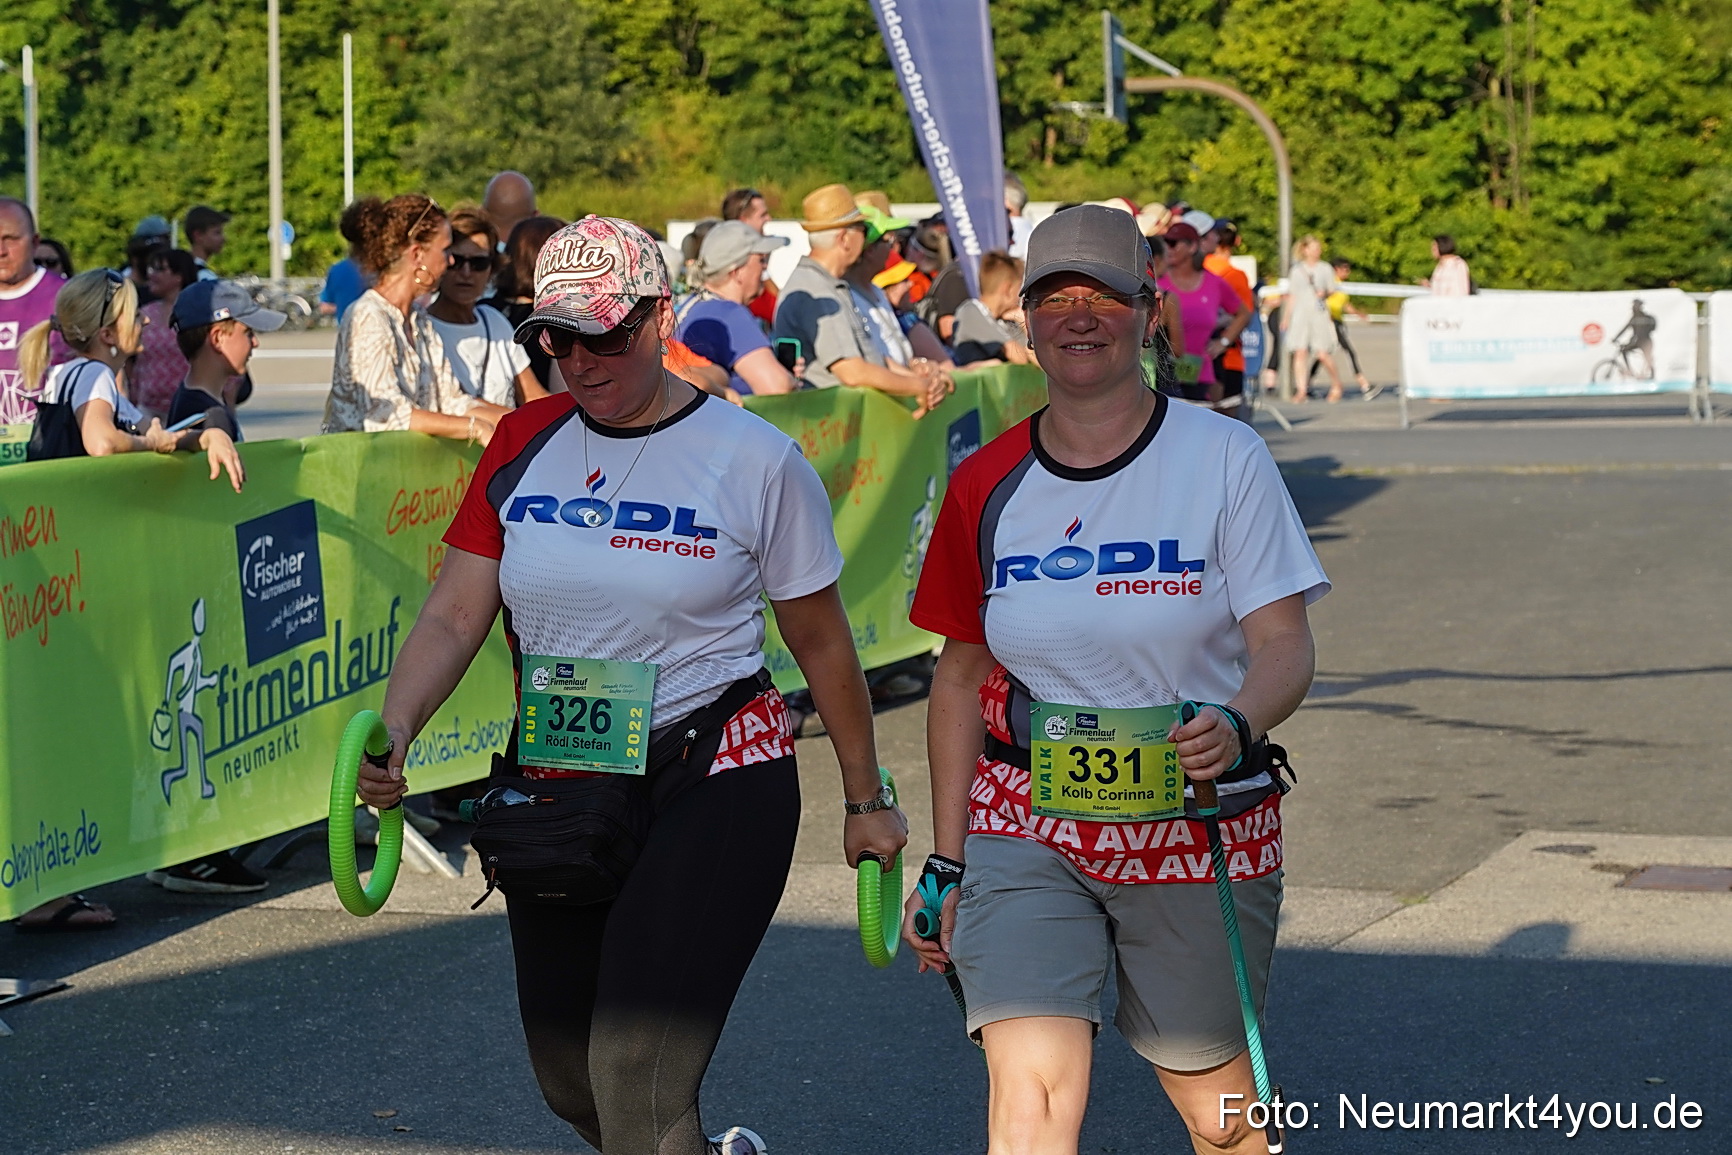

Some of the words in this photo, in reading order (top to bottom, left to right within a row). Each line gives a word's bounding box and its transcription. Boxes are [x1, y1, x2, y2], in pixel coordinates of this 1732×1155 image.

[610, 533, 716, 560] energie
[254, 551, 306, 589] Fischer
[260, 575, 302, 601] AUTOMOBILE
[1095, 569, 1202, 595] energie
[0, 548, 85, 647] länger!
[217, 596, 400, 750] firmenlauf
[550, 677, 588, 686] Firmenlauf
[525, 705, 537, 744] RUN
[547, 695, 613, 735] 326
[626, 707, 643, 758] 2022
[1069, 728, 1116, 737] Firmenlauf
[224, 724, 300, 784] neumarkt
[545, 735, 569, 748] Rödl
[572, 736, 611, 751] Stefan
[1040, 747, 1052, 801] WALK
[1068, 746, 1141, 784] 331
[1165, 751, 1177, 801] 2022
[1062, 785, 1093, 800] Kolb
[1097, 788, 1155, 801] Corinna
[1094, 820, 1195, 851] AVIA
